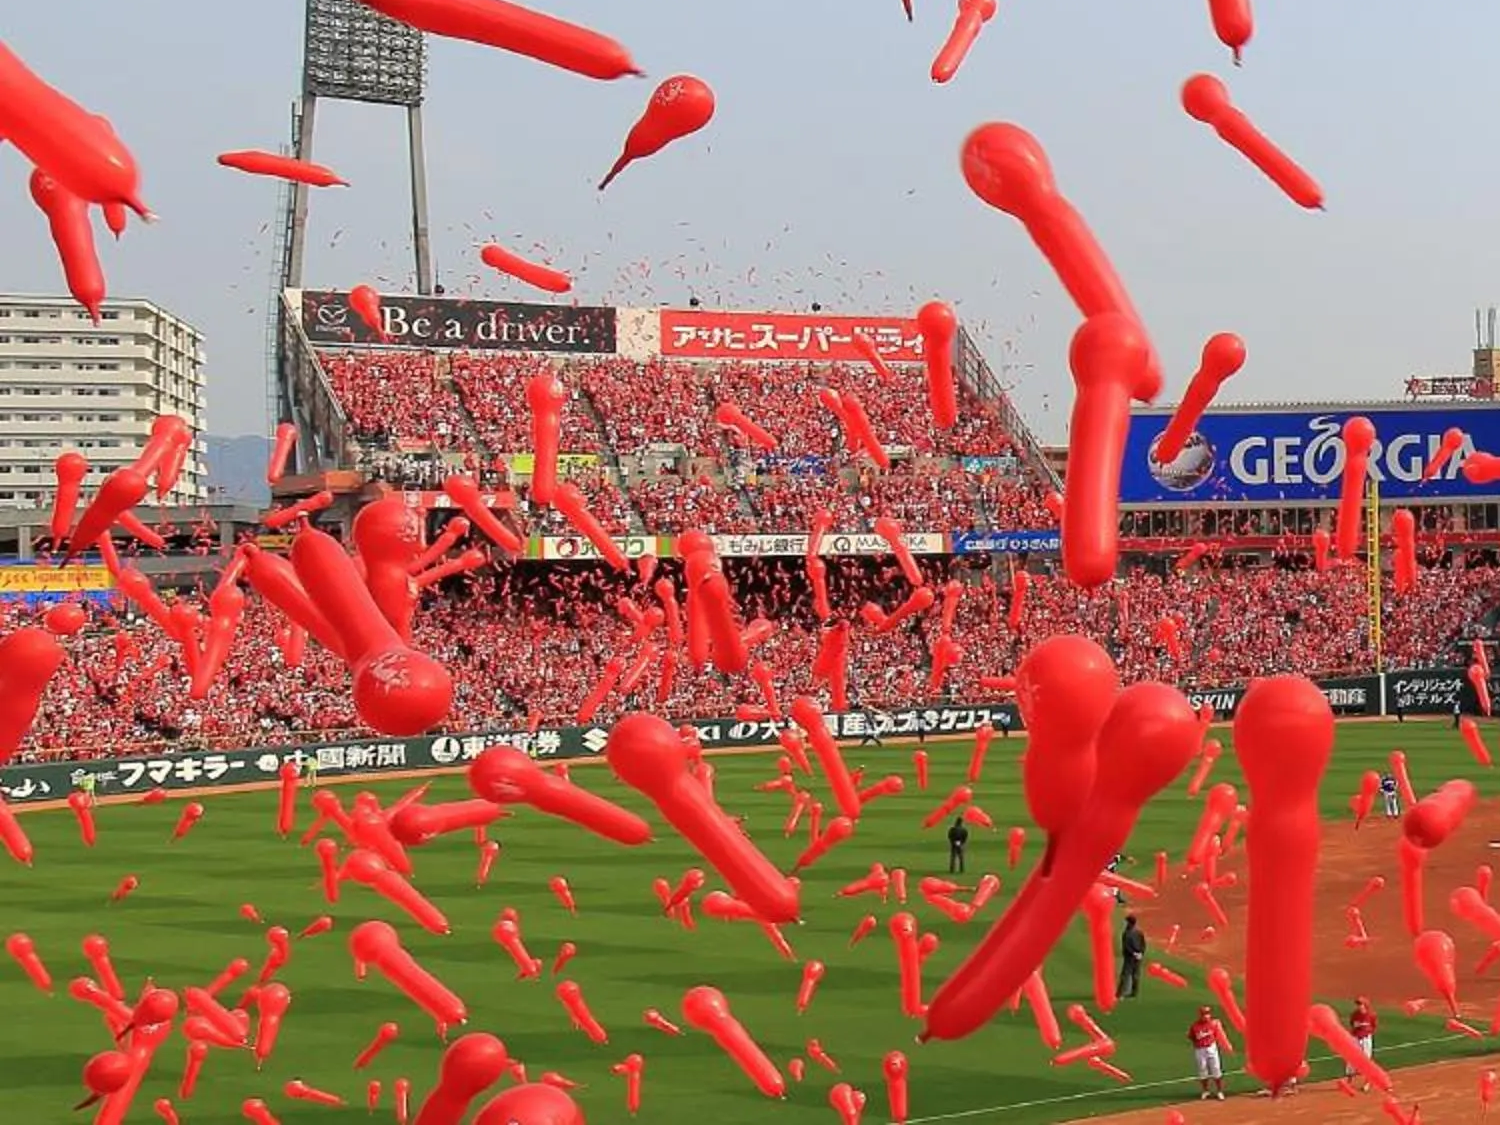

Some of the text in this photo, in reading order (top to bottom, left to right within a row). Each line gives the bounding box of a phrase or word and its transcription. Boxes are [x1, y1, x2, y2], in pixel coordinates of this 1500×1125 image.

[382, 306, 591, 345] Be a driver.
[728, 537, 806, 554] もみじ銀行
[856, 536, 928, 548] MASKA
[1188, 692, 1236, 711] SKIN
[118, 755, 246, 786] フマキラー
